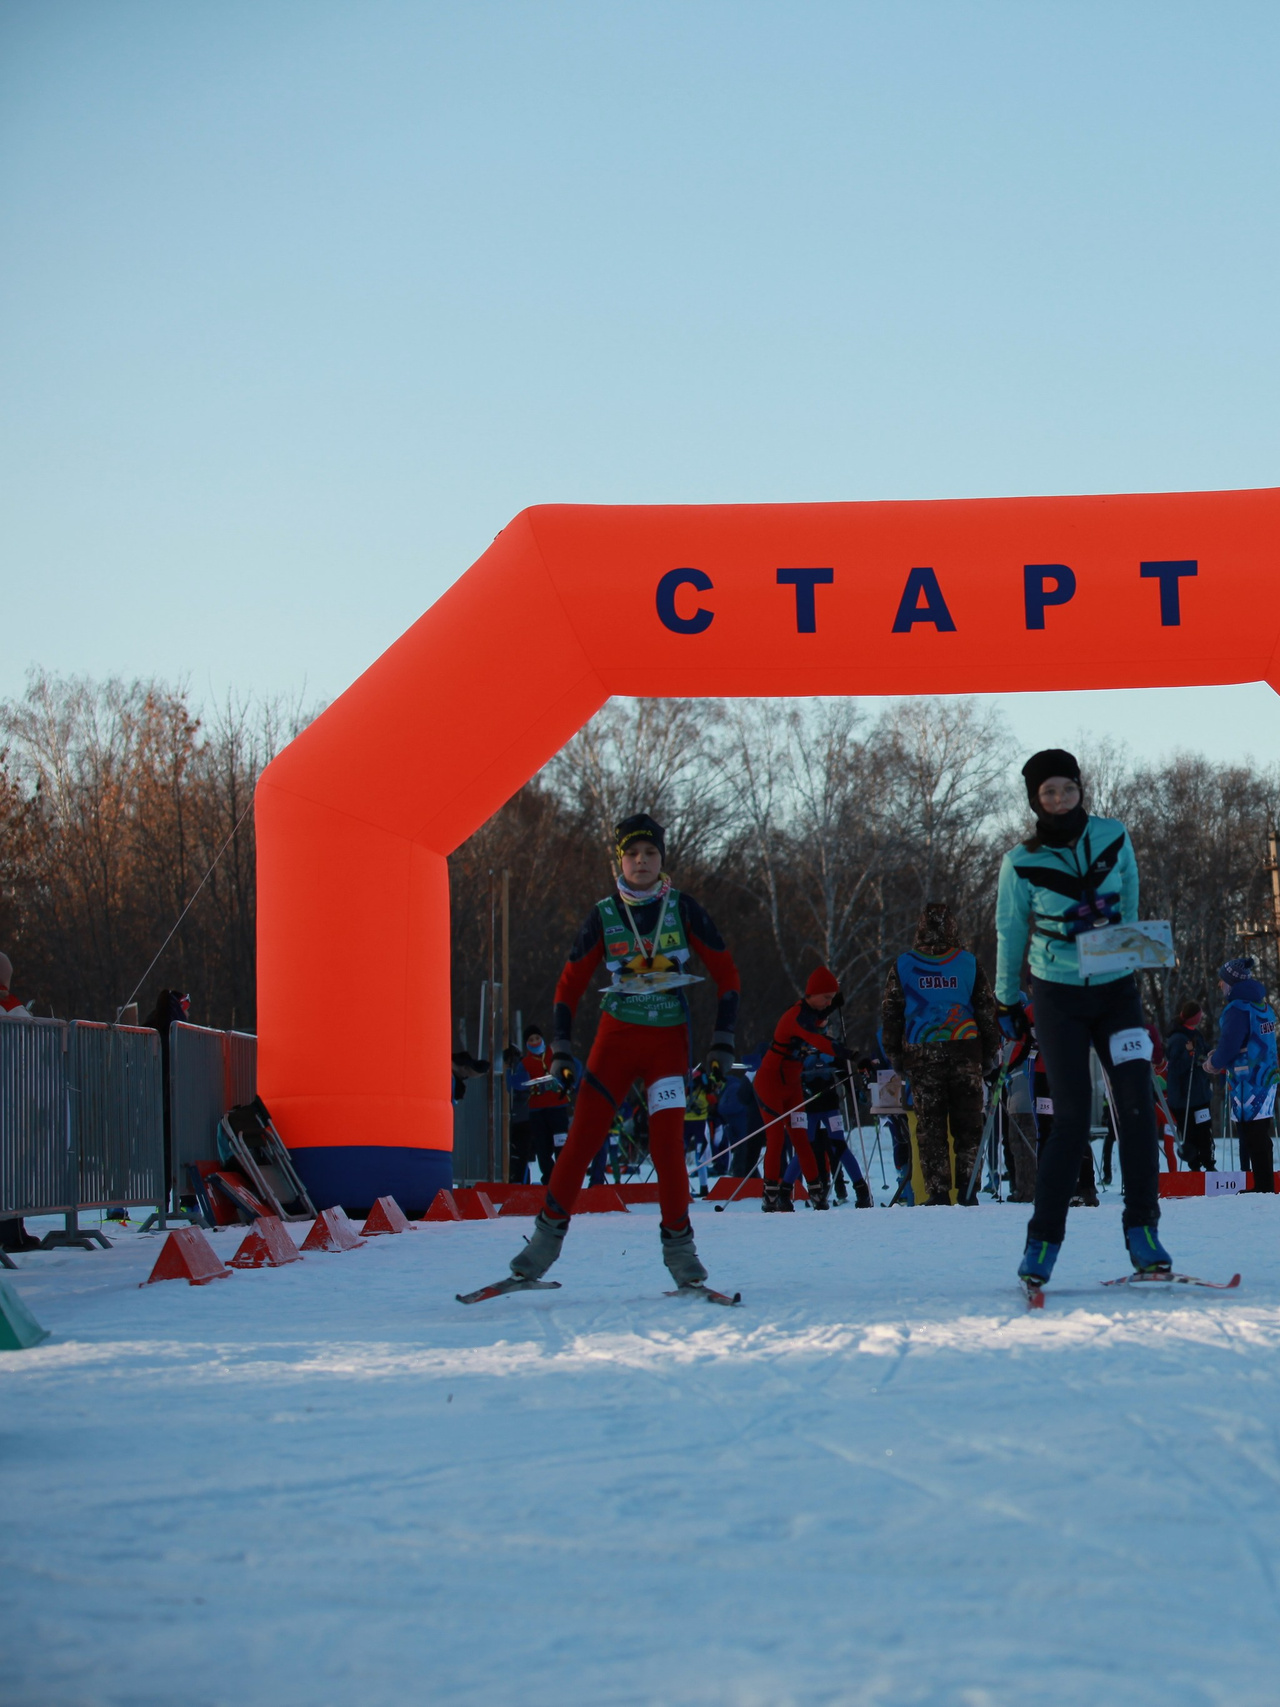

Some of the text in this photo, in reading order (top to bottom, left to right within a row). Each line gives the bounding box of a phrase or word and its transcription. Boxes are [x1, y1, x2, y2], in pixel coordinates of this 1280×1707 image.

[655, 560, 1198, 635] СТАРТ
[919, 976, 958, 989] СУДЬЯ
[1121, 1041, 1142, 1052] 435
[658, 1089, 677, 1102] 335
[1215, 1181, 1236, 1190] 1-10
